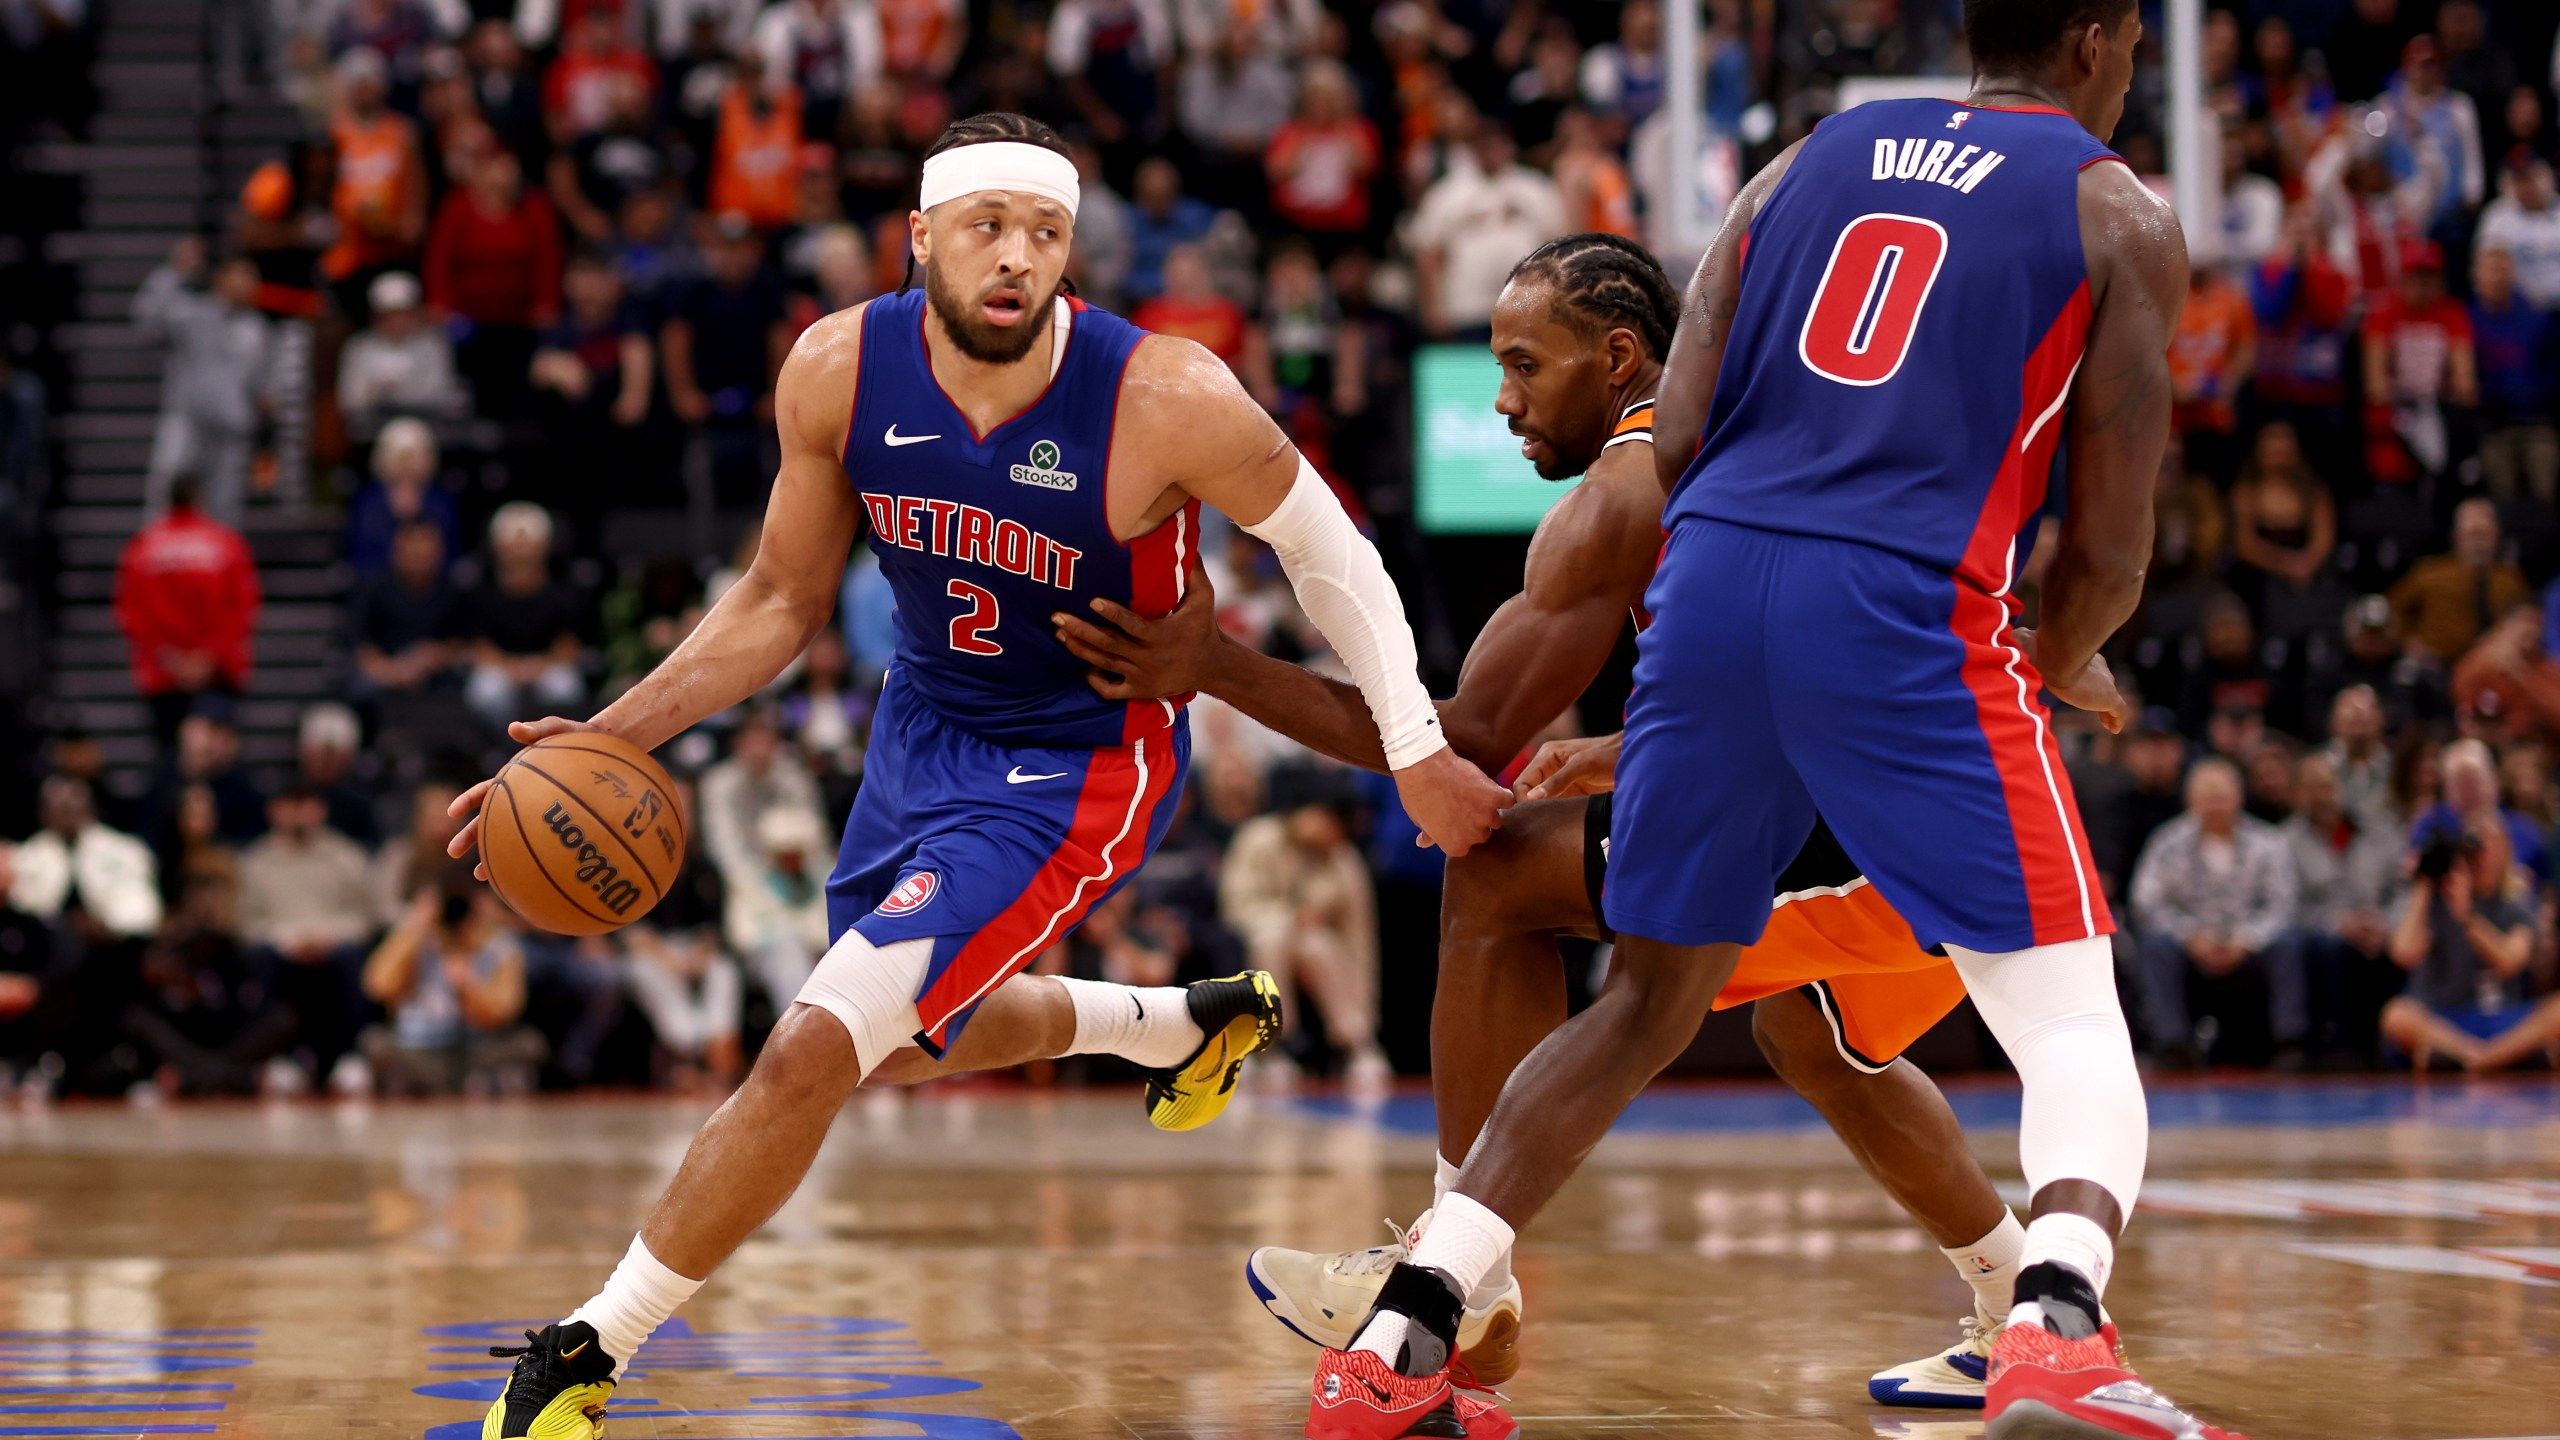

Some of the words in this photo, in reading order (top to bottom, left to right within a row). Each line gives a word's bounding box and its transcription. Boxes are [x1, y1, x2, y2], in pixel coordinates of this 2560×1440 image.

[1872, 138, 2006, 194] DUREN
[1798, 212, 1948, 387] 0
[1011, 466, 1074, 489] StockX
[861, 492, 1083, 591] DETROIT
[947, 578, 1003, 656] 2
[542, 799, 642, 917] Wilson
